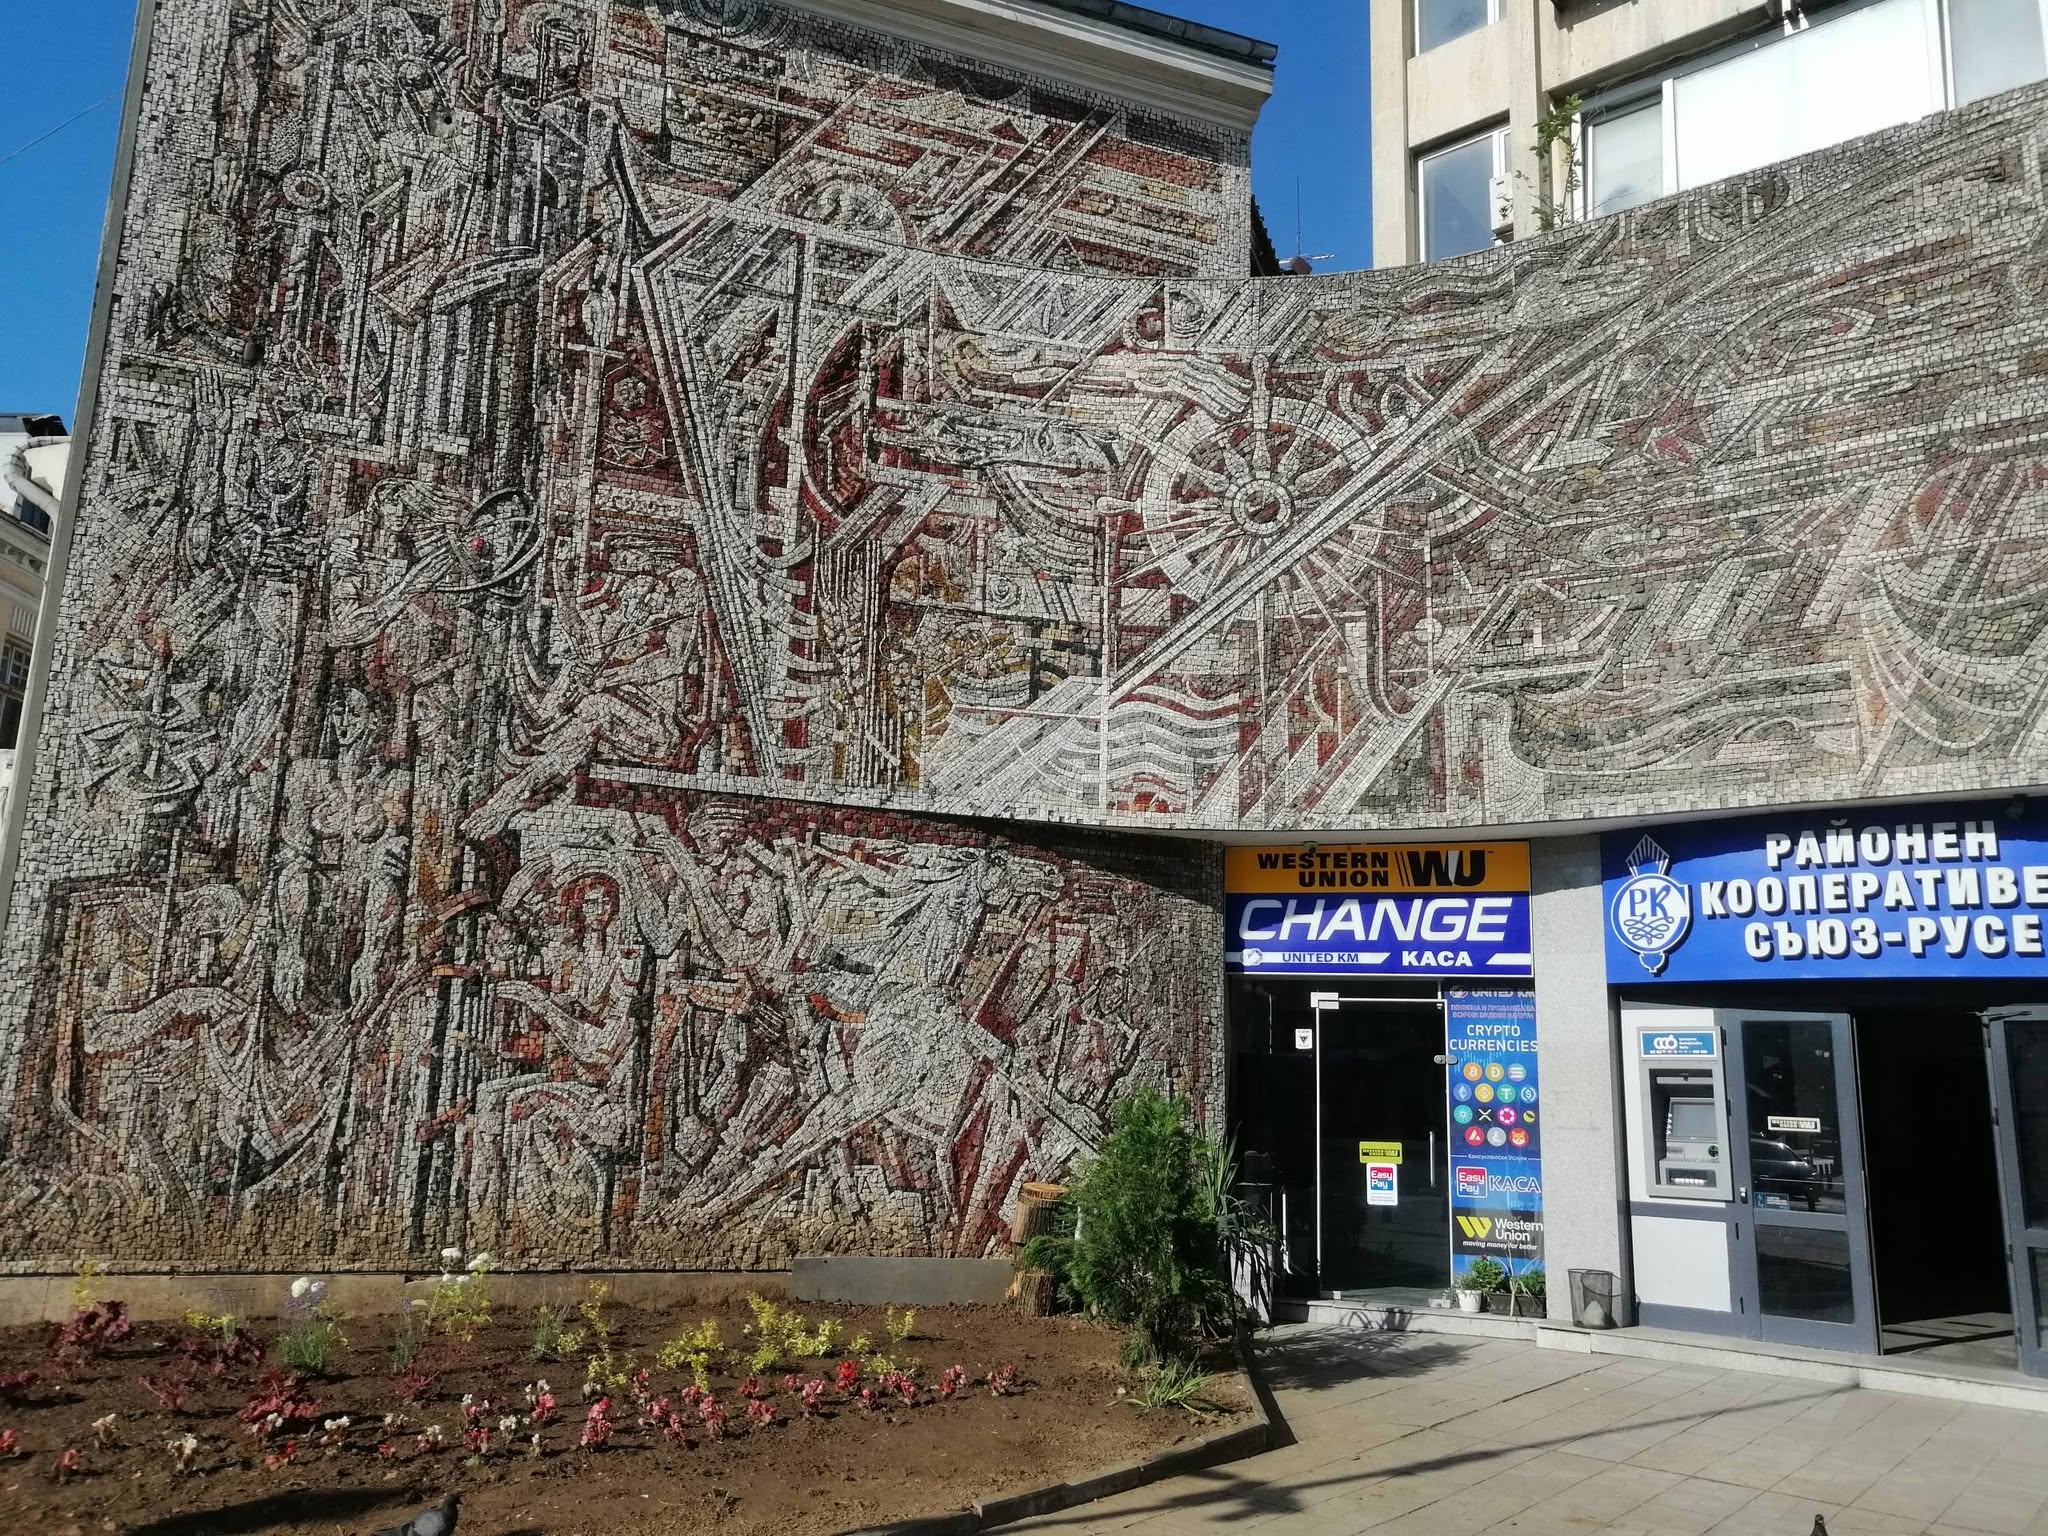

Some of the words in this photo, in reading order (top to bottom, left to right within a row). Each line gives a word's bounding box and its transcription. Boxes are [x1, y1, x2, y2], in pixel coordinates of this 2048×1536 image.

[1766, 819, 1998, 867] РАЙОНЕН
[1257, 851, 1389, 869] WESTERN
[1406, 850, 1487, 887] WU
[1299, 870, 1389, 888] UNION
[1701, 865, 2048, 915] КООПЕРАТИВЕ
[1238, 897, 1513, 942] CHANGE
[1744, 914, 2043, 959] СЪЮЗ-РУСЕ
[1282, 952, 1334, 963] UNITED
[1337, 952, 1359, 963] KM
[1402, 950, 1473, 967] КАСА
[1471, 987, 1514, 998] UNITED
[1466, 1024, 1521, 1037] CRYPTO
[1449, 1039, 1538, 1052] CURRENCIES
[1371, 1170, 1393, 1180] Easy
[1458, 1172, 1485, 1185] Easy
[1371, 1179, 1388, 1190] Pay
[1459, 1182, 1480, 1195] Pay
[1489, 1175, 1542, 1193] КАСА
[1494, 1218, 1544, 1231] Western
[1495, 1229, 1530, 1241] Union
[1462, 1240, 1486, 1248] moving
